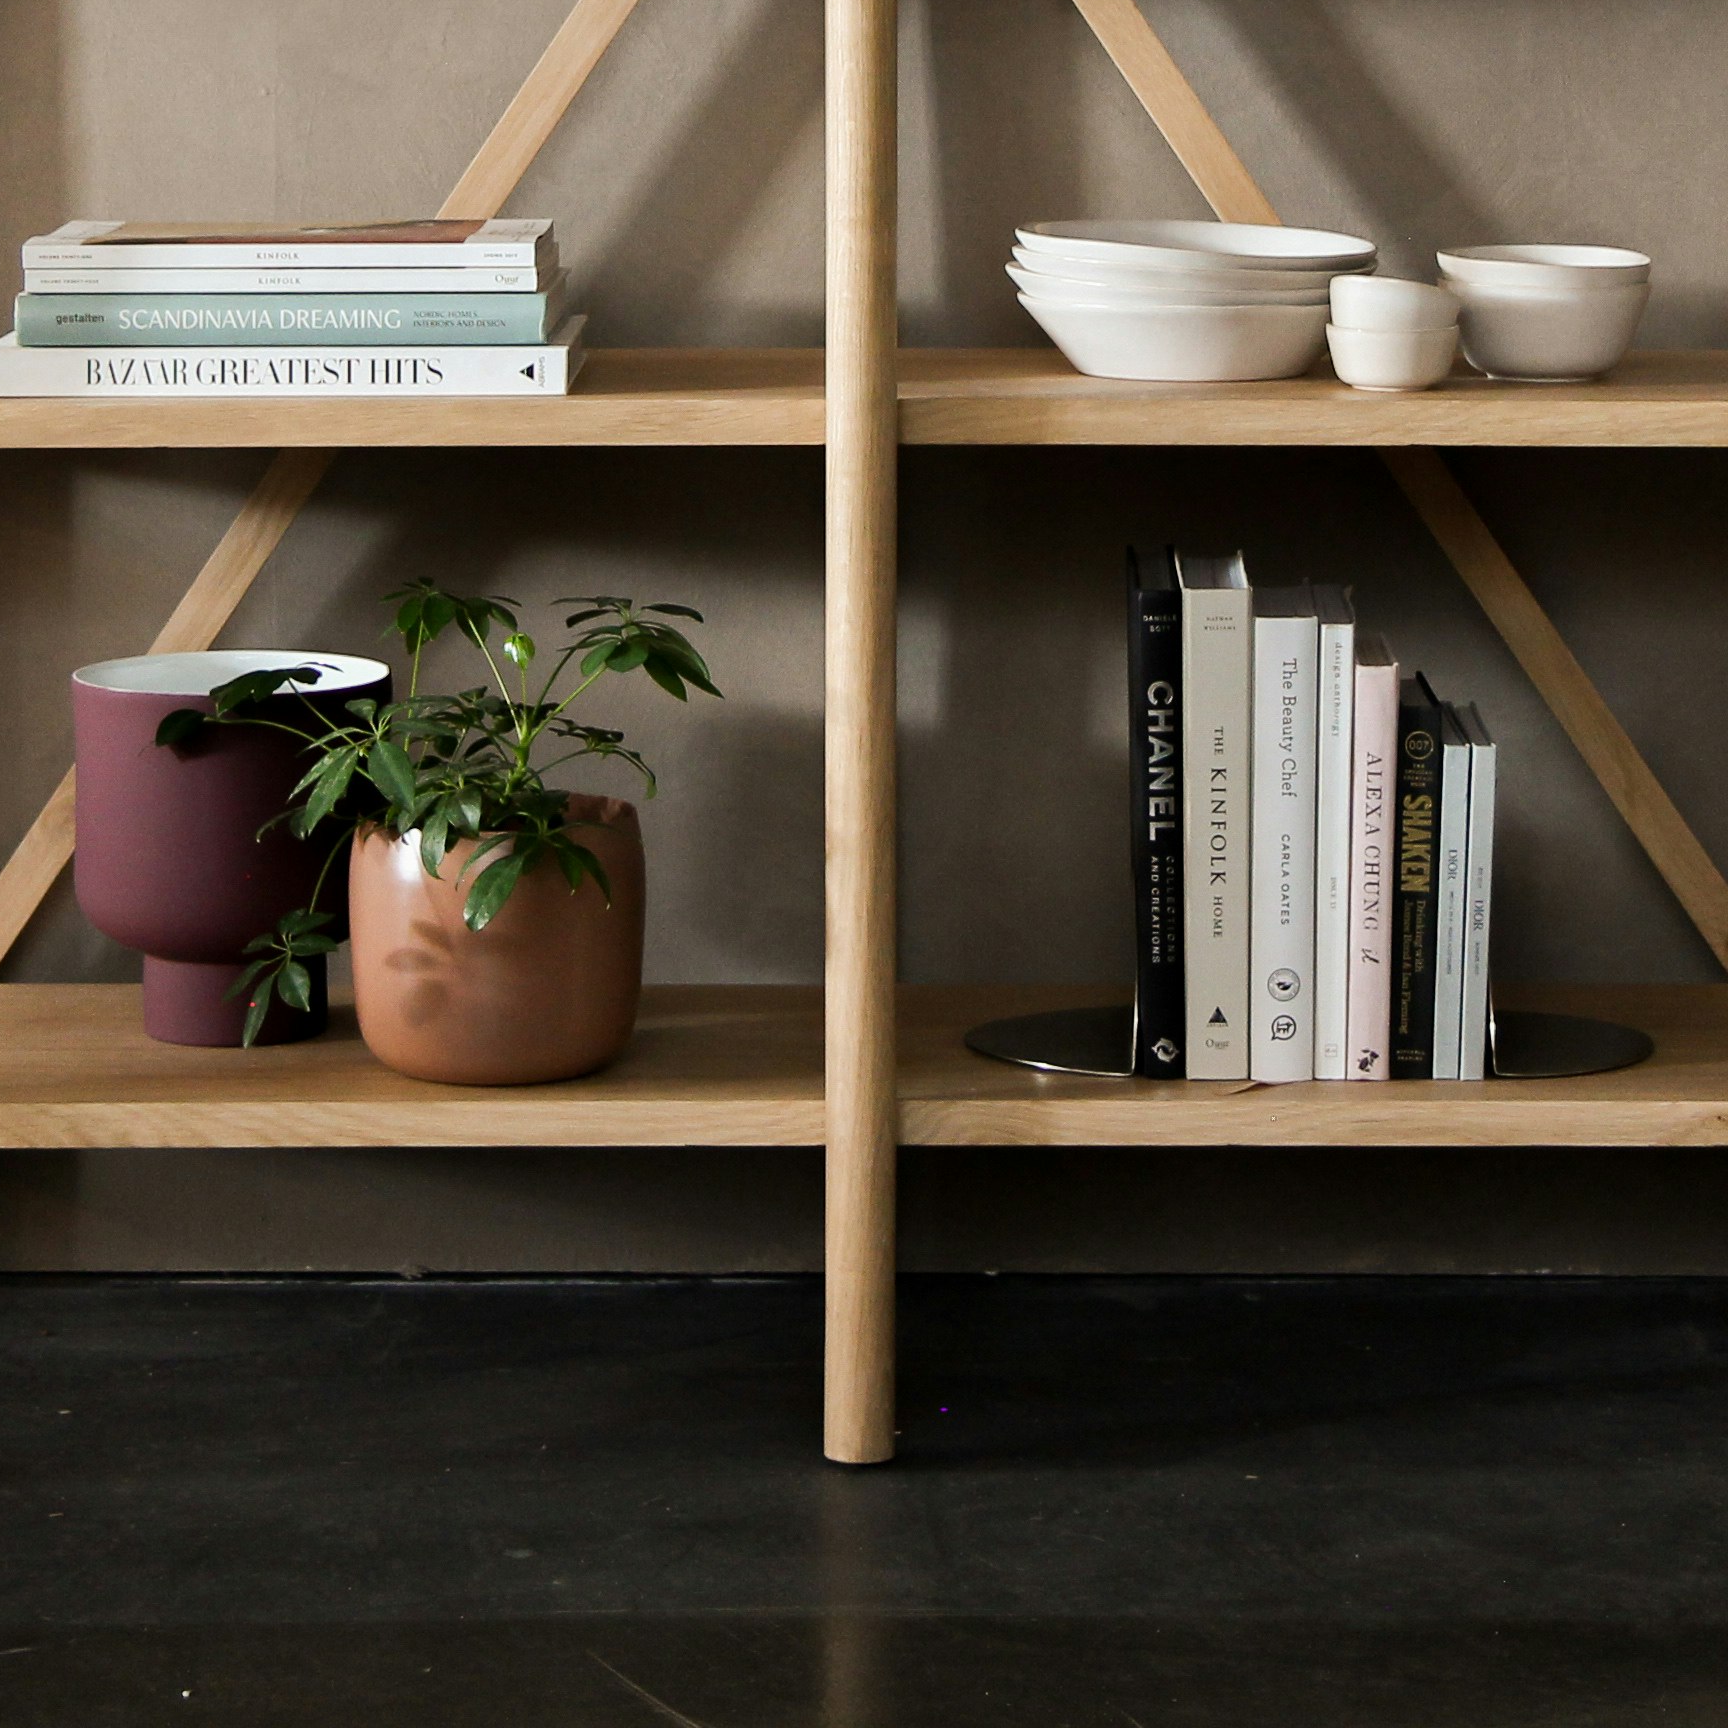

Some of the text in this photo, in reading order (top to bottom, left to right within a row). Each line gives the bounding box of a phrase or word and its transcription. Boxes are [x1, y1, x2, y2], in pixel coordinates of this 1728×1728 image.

[256, 252, 300, 260] KINFOLK
[258, 277, 301, 285] KINFOLK
[56, 313, 104, 325] gestalten
[118, 308, 402, 330] SCANDINAVIA DREAMING
[413, 319, 506, 328] INTERIORS AND DESIGN
[86, 358, 444, 385] BAZAAR GREATEST HITS
[1332, 642, 1343, 679] design
[1279, 658, 1298, 797] The Beauty Chef
[1408, 740, 1429, 750] 007
[1147, 680, 1175, 841] CHANEL
[1210, 726, 1227, 938] THE KINFOLK HOME
[1363, 752, 1382, 931] ALEXA CHUNG
[1400, 794, 1433, 892] SHAKEN
[1280, 833, 1291, 926] CARLA OATES
[1447, 849, 1458, 880] DIOR
[1150, 856, 1161, 964] AND CREATIONS
[1166, 855, 1176, 963] COLLECTIONS
[1473, 900, 1484, 931] DIOR
[1402, 934, 1413, 960] Bond
[1413, 899, 1427, 973] Drinking with
[1398, 992, 1411, 1035] Fleming
